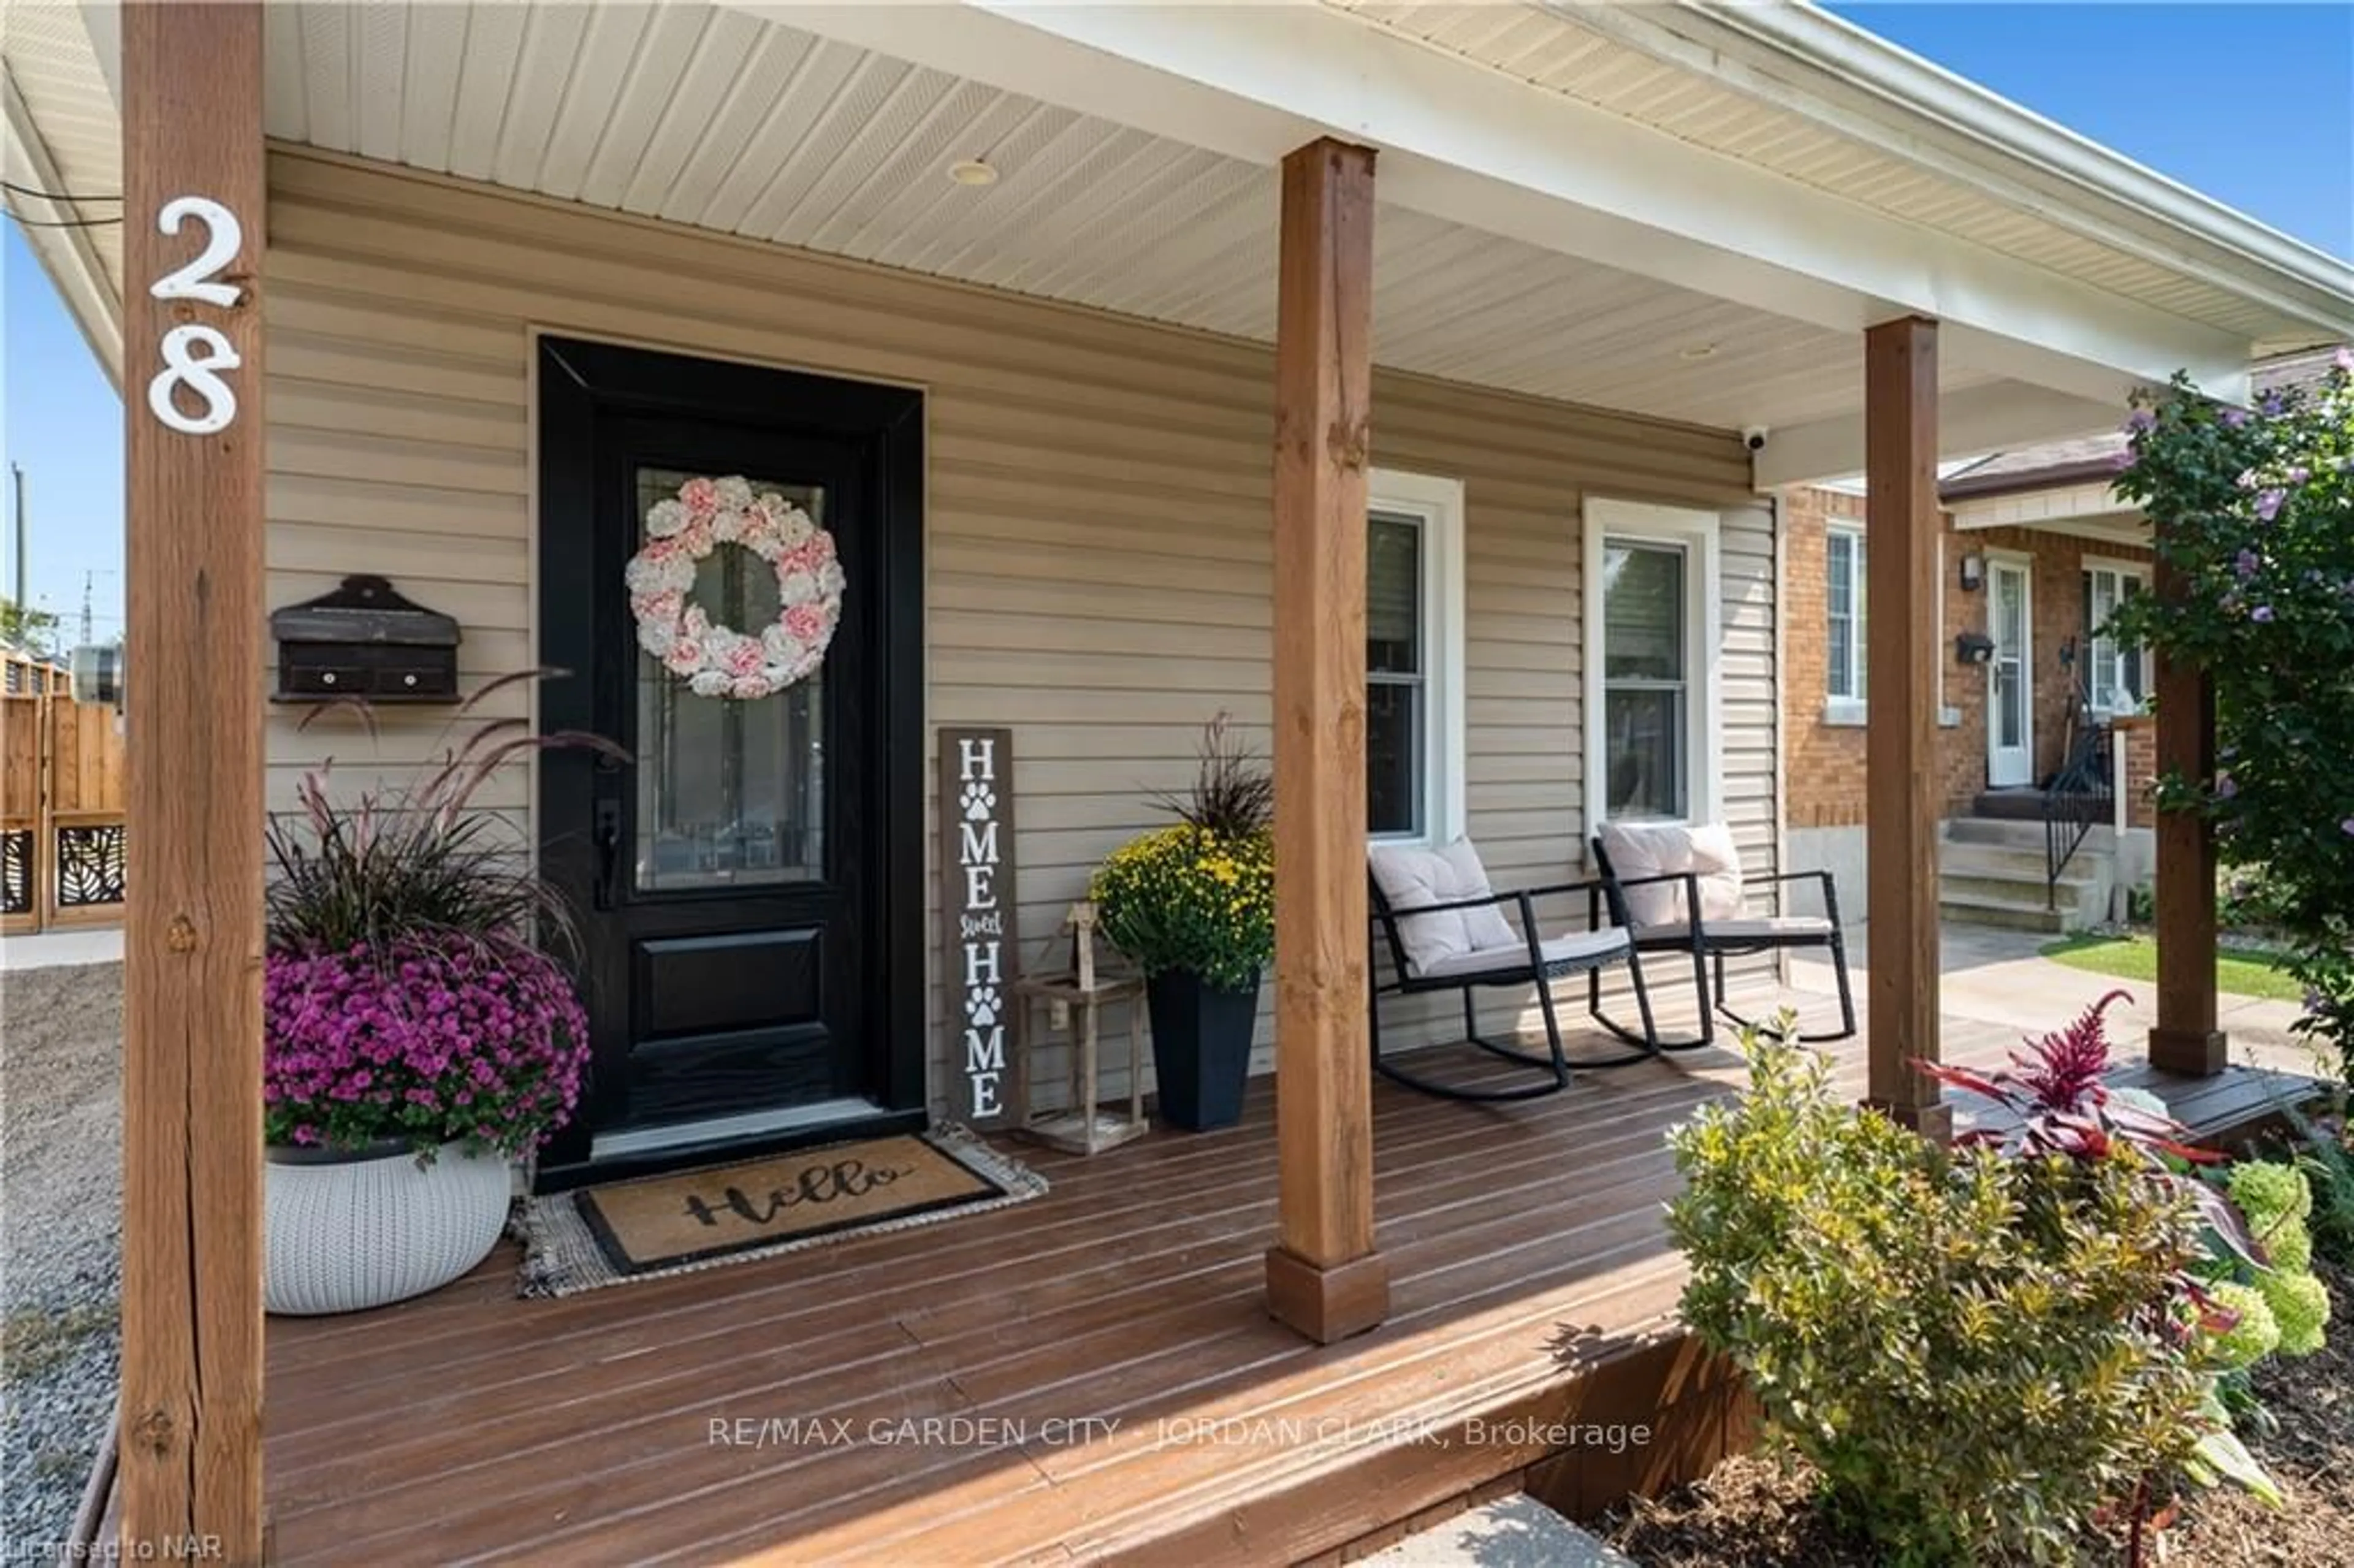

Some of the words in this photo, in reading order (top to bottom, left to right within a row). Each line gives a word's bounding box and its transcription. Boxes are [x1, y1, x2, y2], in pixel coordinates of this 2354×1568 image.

[149, 196, 242, 434] 28
[959, 739, 1000, 909] HME
[964, 942, 1005, 1118] HME
[683, 1160, 914, 1225] Hello
